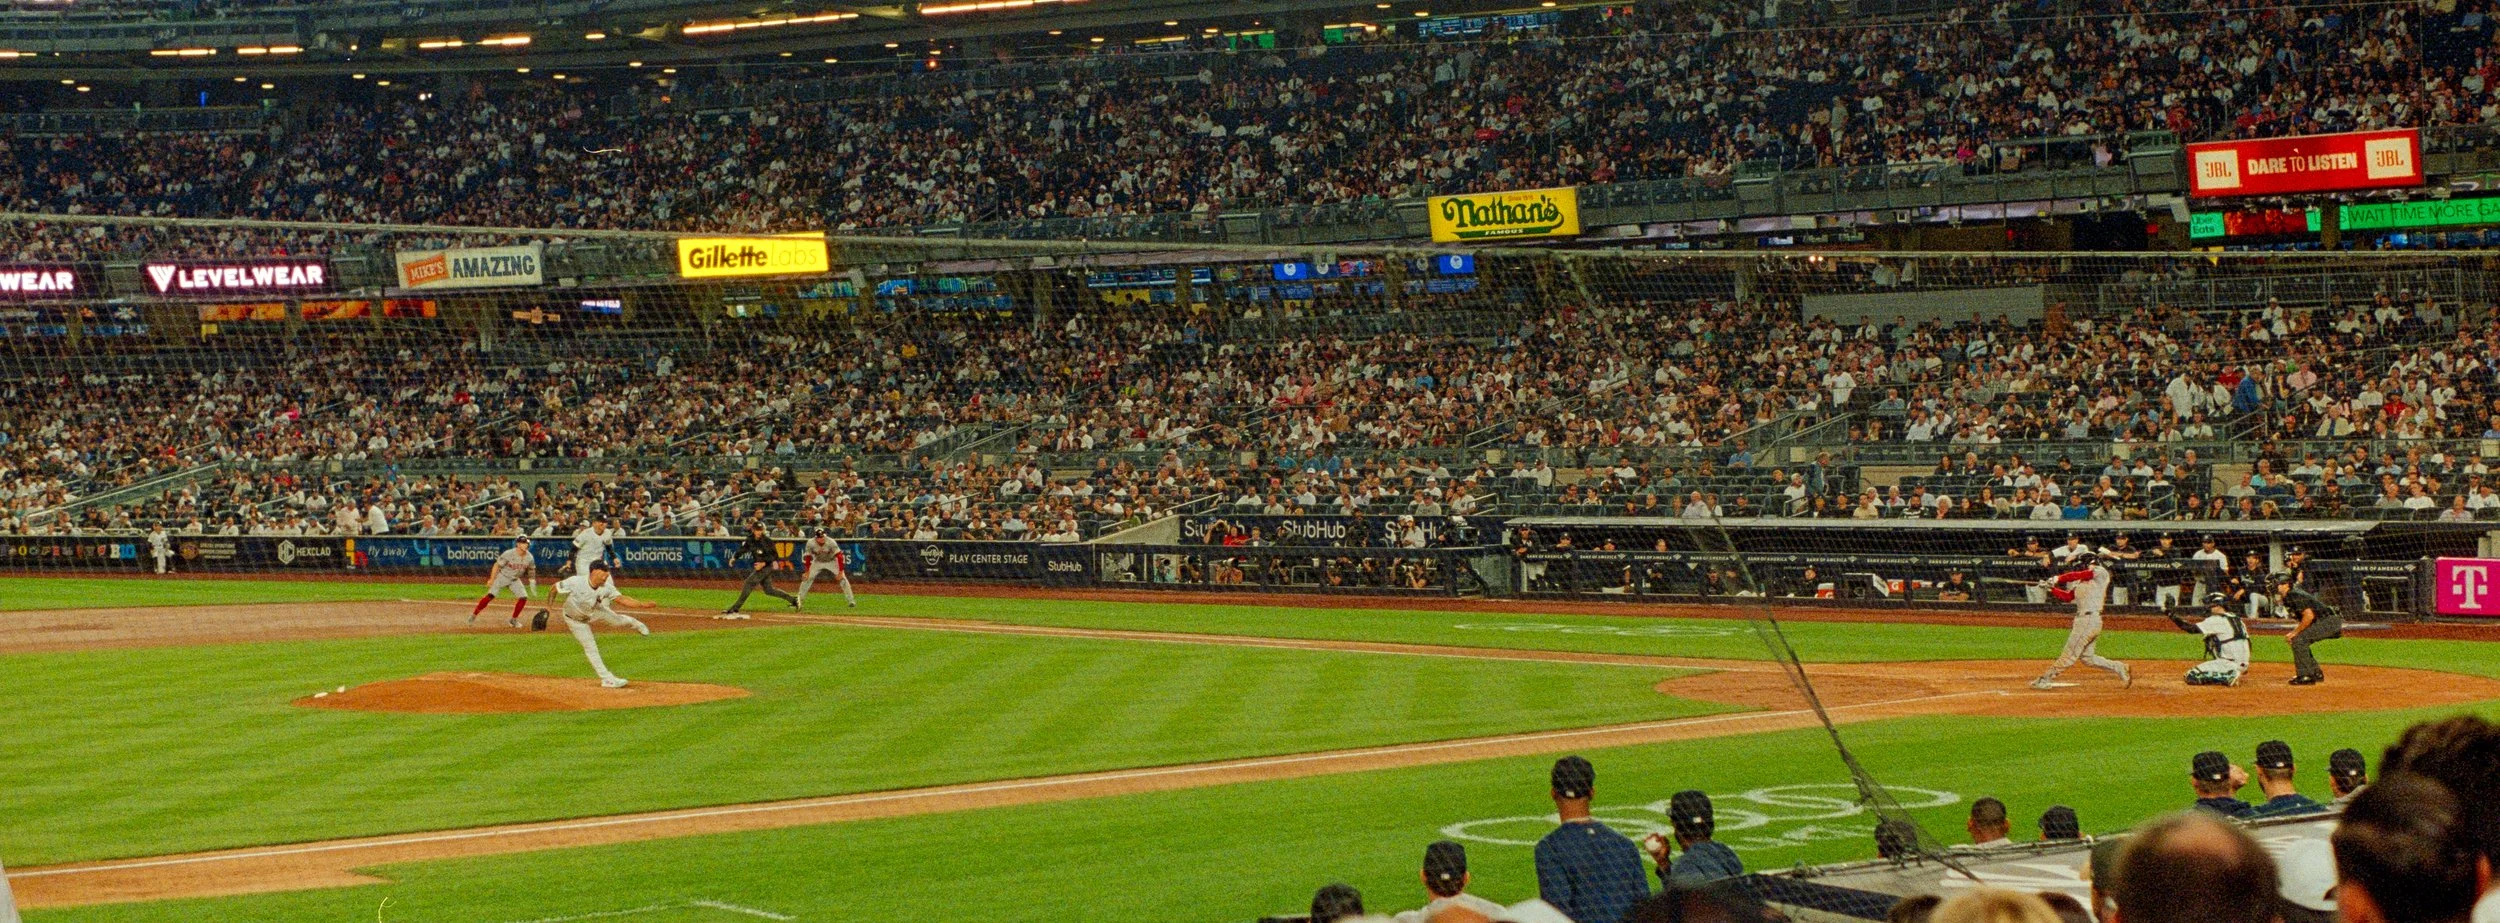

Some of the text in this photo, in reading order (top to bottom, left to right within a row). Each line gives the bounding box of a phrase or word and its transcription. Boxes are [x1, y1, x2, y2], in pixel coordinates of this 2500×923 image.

[2247, 151, 2358, 176] DARE TO LISTEN
[2375, 149, 2404, 169] JBL
[2205, 161, 2232, 179] JBL
[1441, 194, 1564, 230] Nathan's
[2350, 208, 2387, 224] WAIT
[2391, 205, 2426, 220] TIME
[2430, 203, 2473, 218] MORE
[1485, 228, 1524, 237] FAMOUS
[2193, 224, 2216, 234] Eats
[410, 254, 536, 281] MIKE'S AMAZING
[178, 265, 324, 290] LEVELWEAR
[1281, 520, 1346, 540] StubHub
[296, 546, 332, 557] HEXCLAD
[367, 545, 408, 558] fly away
[447, 545, 500, 561] bahamas
[541, 547, 556, 560] fly
[625, 547, 683, 562] bahamas
[949, 553, 1029, 565] PLAY CENTER STAGE
[1047, 560, 1083, 573] StubHub
[2452, 565, 2488, 609] T
